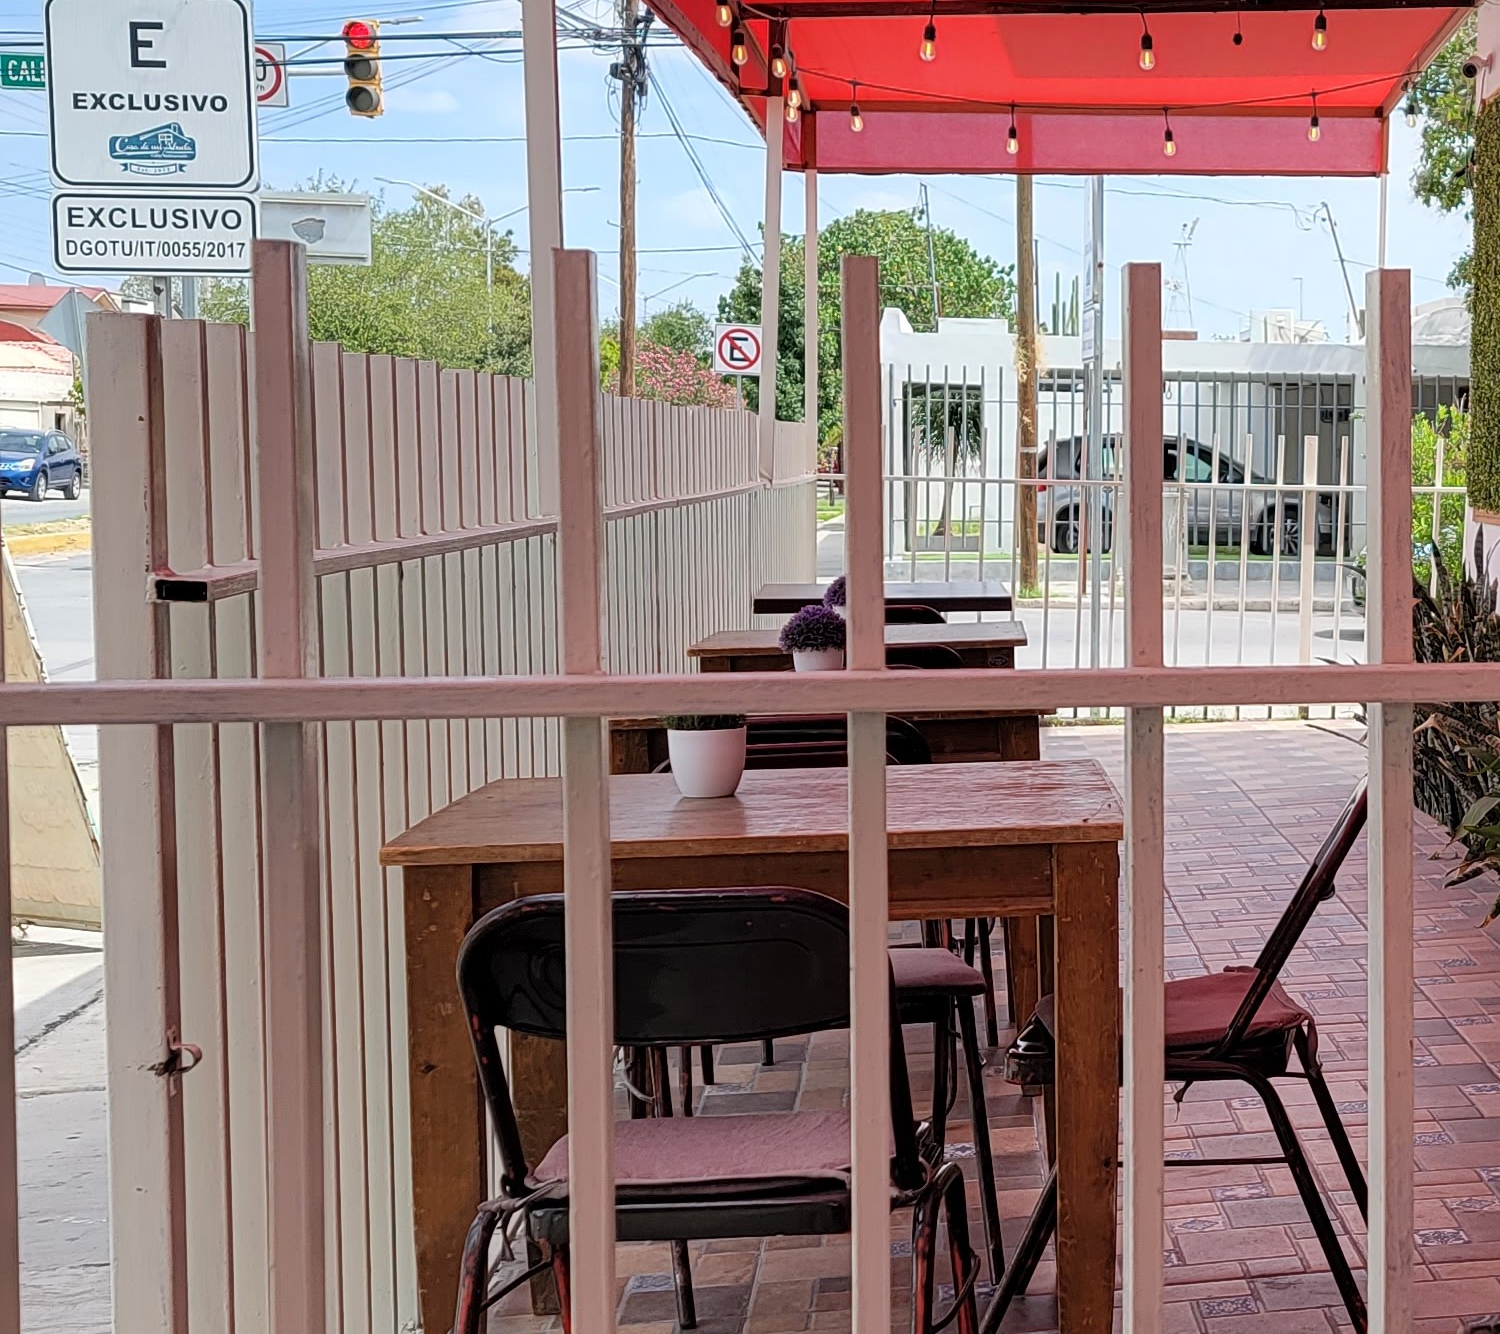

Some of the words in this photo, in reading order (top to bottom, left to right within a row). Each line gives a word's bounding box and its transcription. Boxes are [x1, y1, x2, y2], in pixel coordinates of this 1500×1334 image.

[129, 21, 167, 69] E
[72, 92, 228, 112] EXCLUSIVO
[67, 206, 242, 230] EXCLUSIVO
[66, 240, 245, 259] DGOTU/IT/0055/2017
